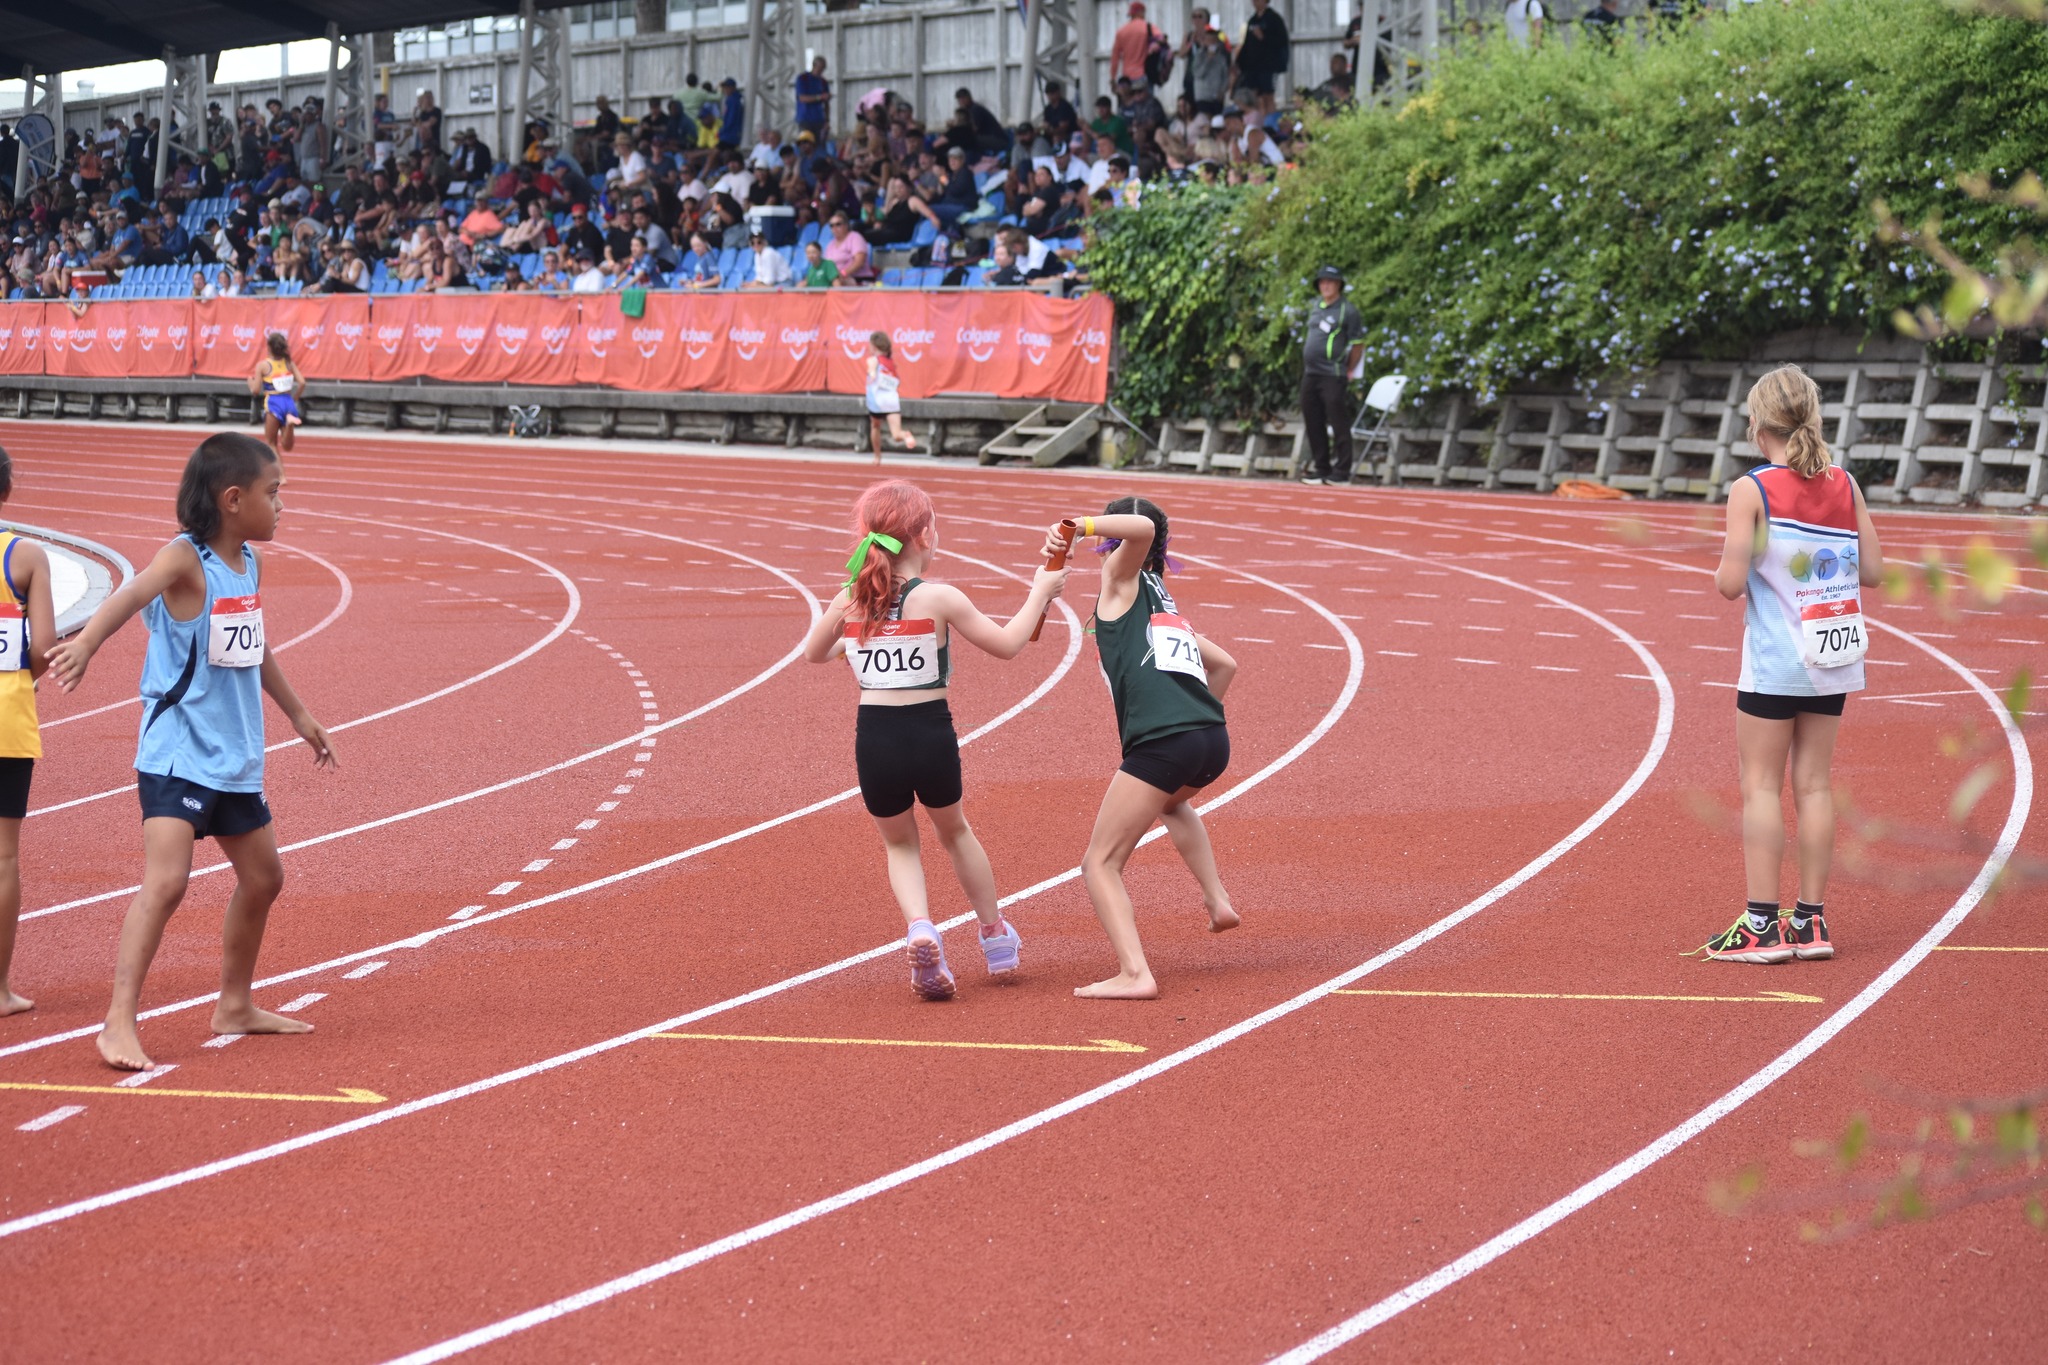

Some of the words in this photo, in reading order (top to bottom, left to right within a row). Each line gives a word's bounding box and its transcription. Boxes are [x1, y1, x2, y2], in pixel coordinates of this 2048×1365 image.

[729, 326, 766, 347] Colgate
[781, 327, 820, 347] Colgate
[893, 327, 935, 347] Colgate
[956, 327, 1001, 347] Colgate
[1816, 625, 1861, 654] 7074
[857, 646, 925, 674] 7016
[1166, 636, 1203, 669] 711
